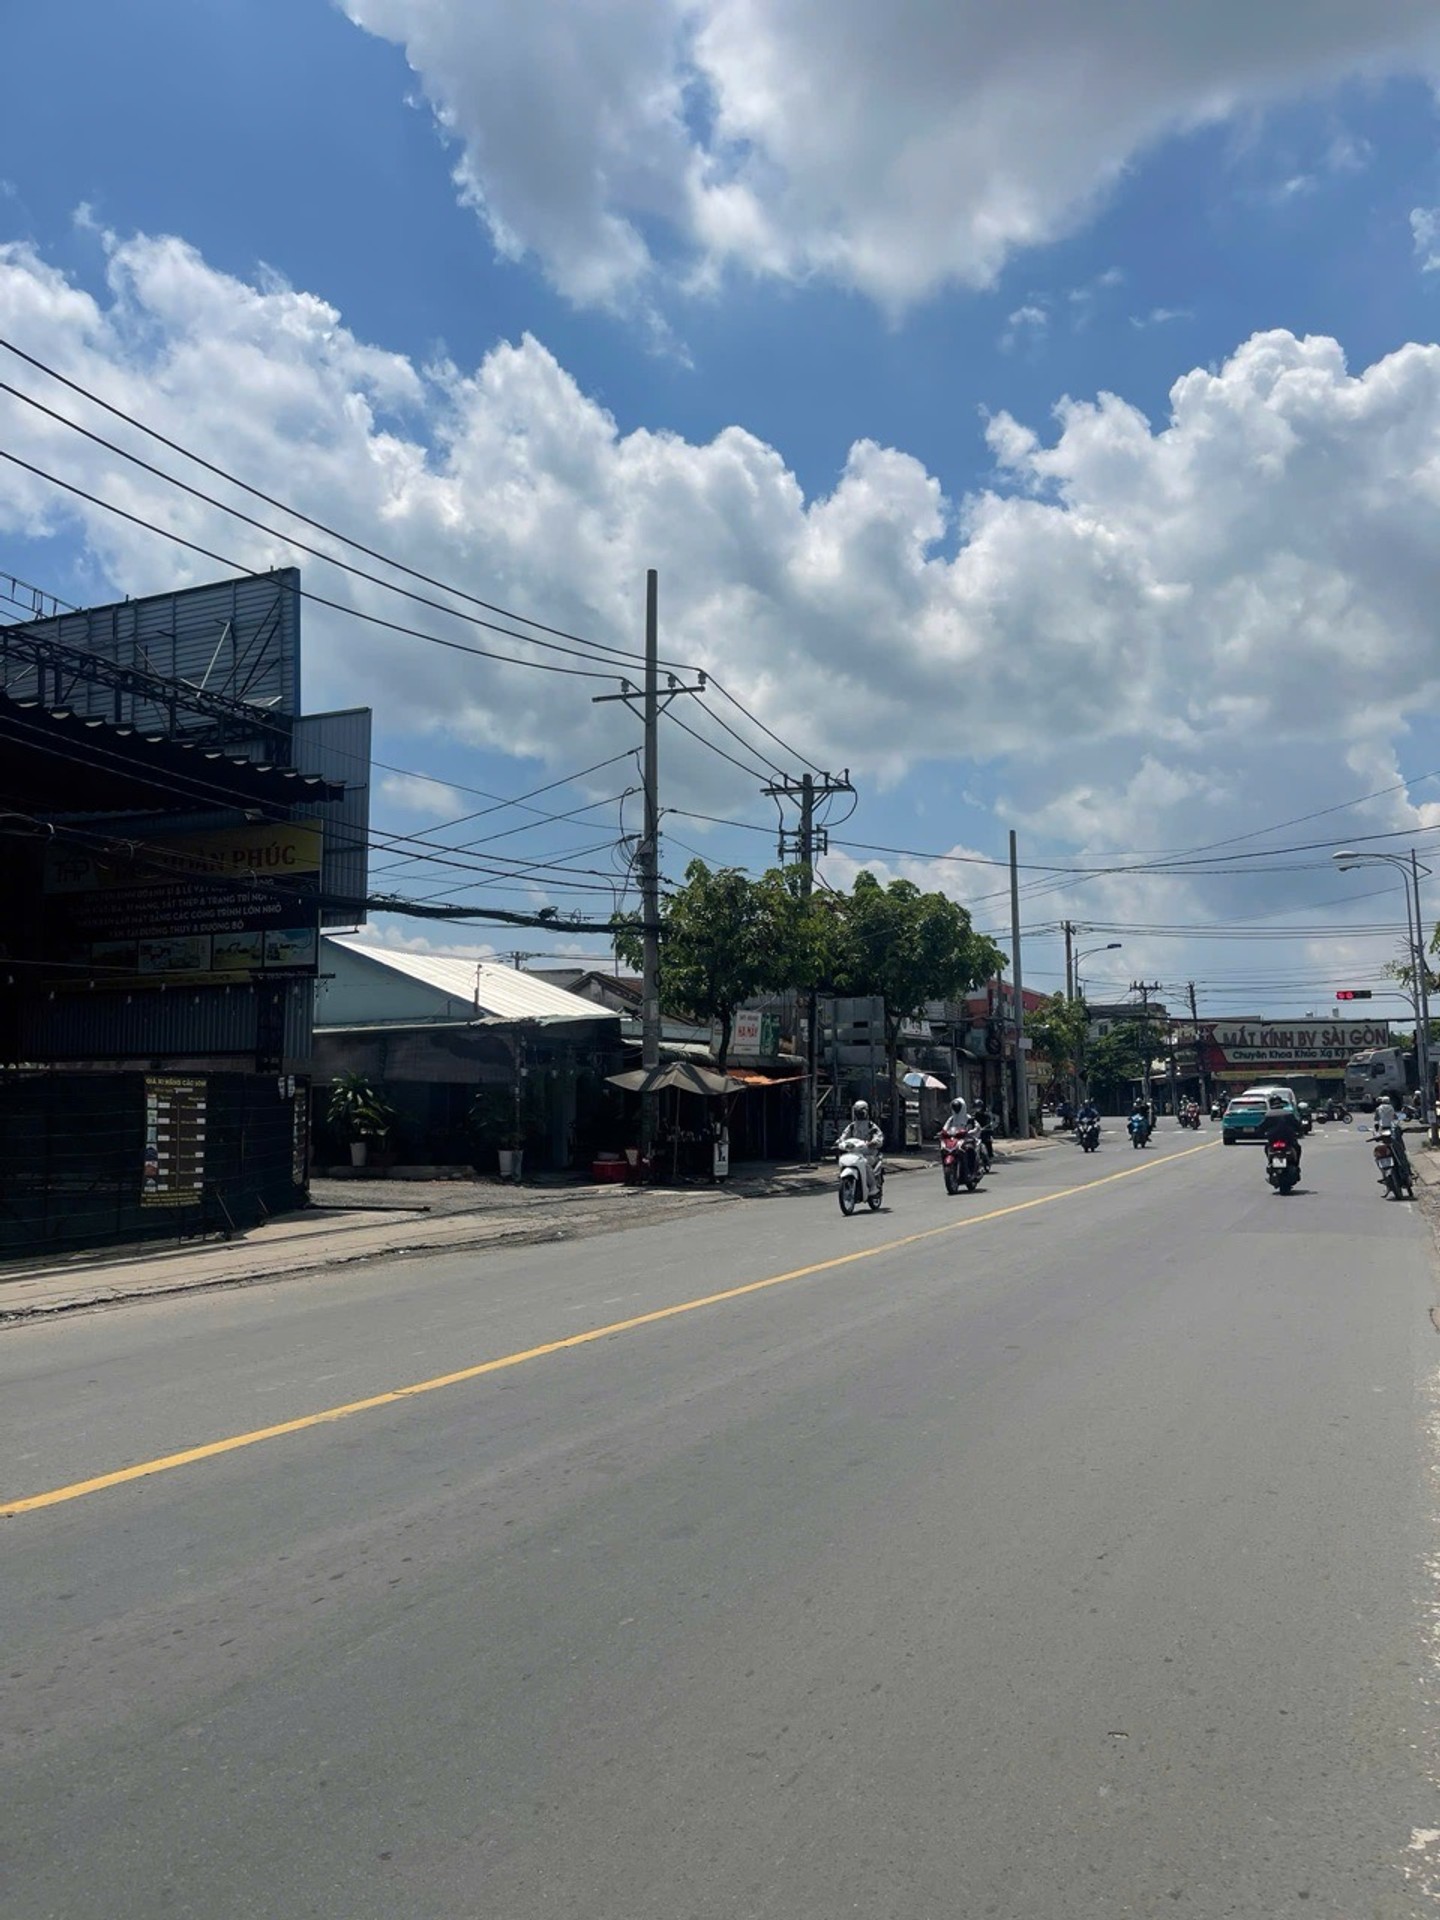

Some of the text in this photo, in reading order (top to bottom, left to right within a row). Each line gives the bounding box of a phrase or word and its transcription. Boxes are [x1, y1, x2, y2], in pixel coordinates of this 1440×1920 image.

[231, 841, 296, 869] PHÚC
[208, 895, 236, 905] TRANG
[172, 909, 190, 921] CÁC
[190, 907, 216, 920] CÔNG
[217, 904, 242, 917] TRÌNH
[1222, 1025, 1387, 1048] MẮT KÍNH BV SÀI GÒN
[1232, 1049, 1267, 1061] Chuyên
[1269, 1050, 1293, 1059] Khoa
[1295, 1049, 1317, 1059] Khúc
